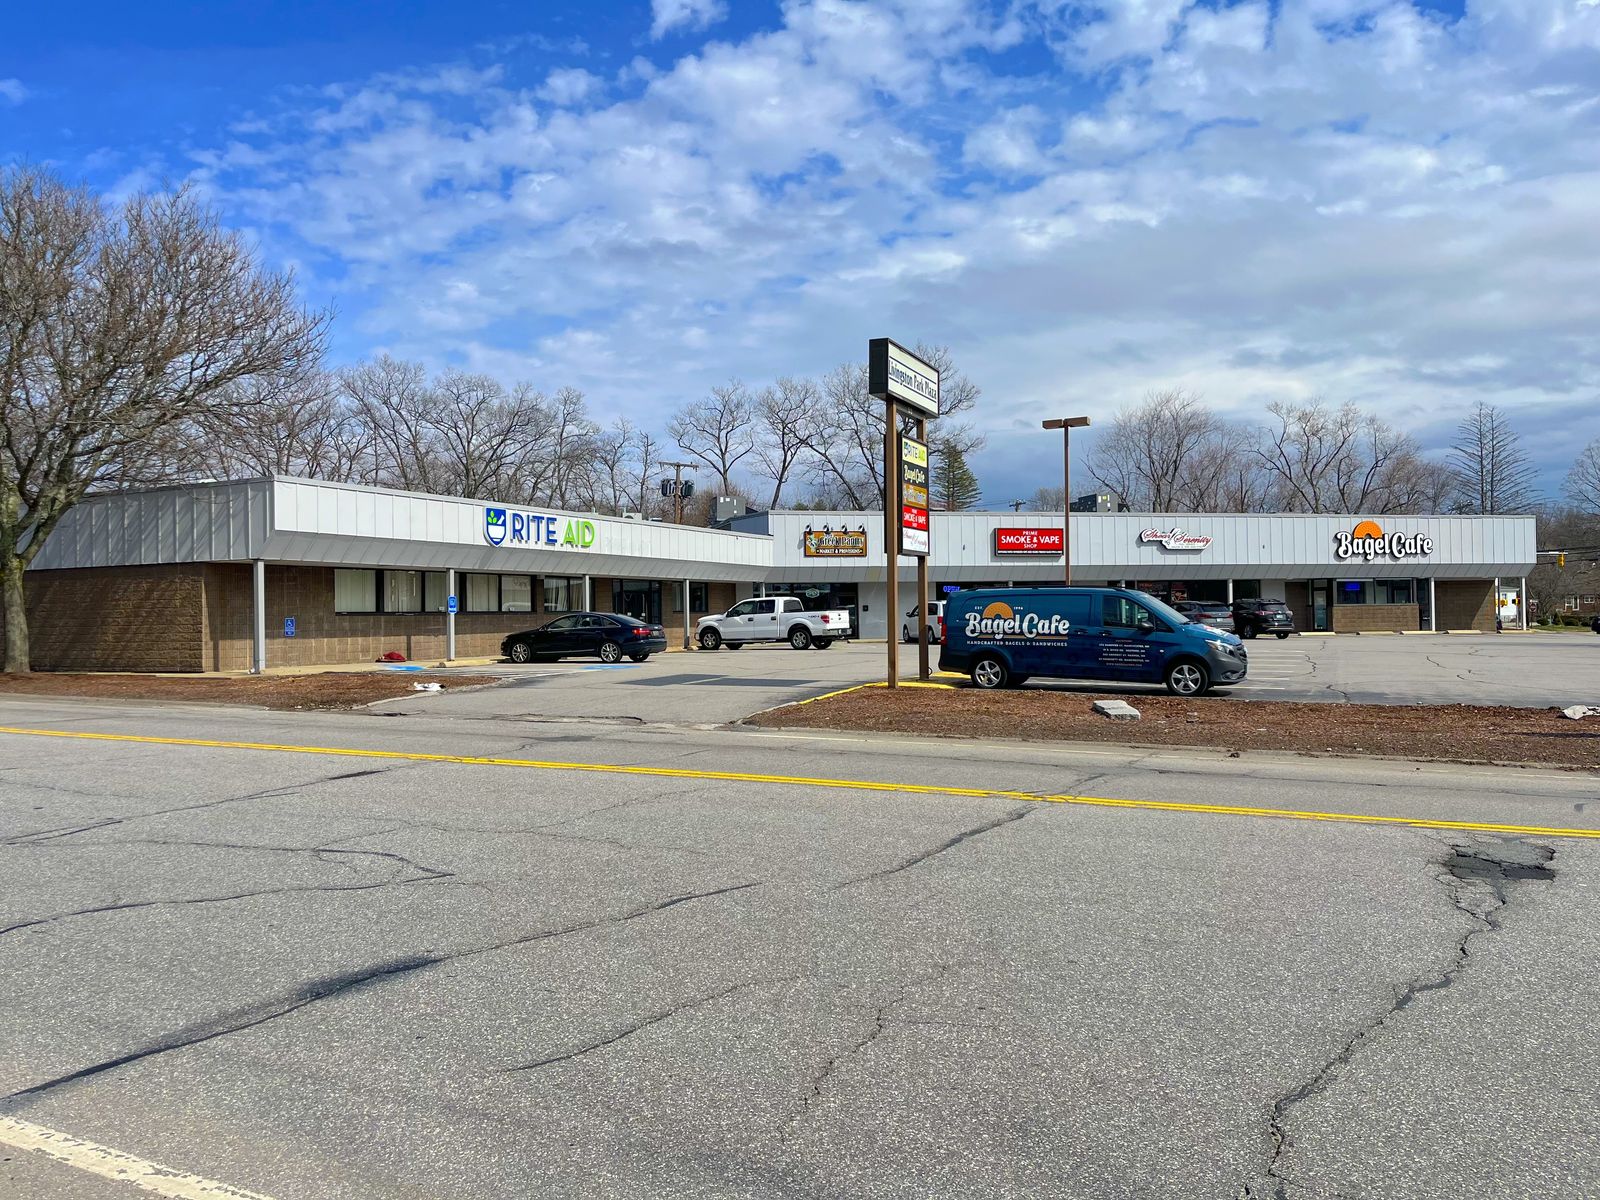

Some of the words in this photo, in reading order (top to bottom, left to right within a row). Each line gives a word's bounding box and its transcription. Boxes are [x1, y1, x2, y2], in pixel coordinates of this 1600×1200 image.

[889, 359, 913, 387] Livingston
[914, 374, 924, 393] Park
[925, 381, 936, 399] Plaza
[512, 512, 557, 544] RITE
[562, 519, 595, 546] AID
[818, 536, 841, 547] Greek
[1001, 535, 1031, 544] SMOKE
[1040, 535, 1060, 544] VAPE
[1143, 529, 1171, 541] Shear
[1173, 531, 1212, 547] Serenity
[1336, 531, 1391, 560] Bagel
[1391, 531, 1433, 558] Cafe
[964, 612, 1021, 640] Bagel
[1022, 613, 1070, 638] Cafe
